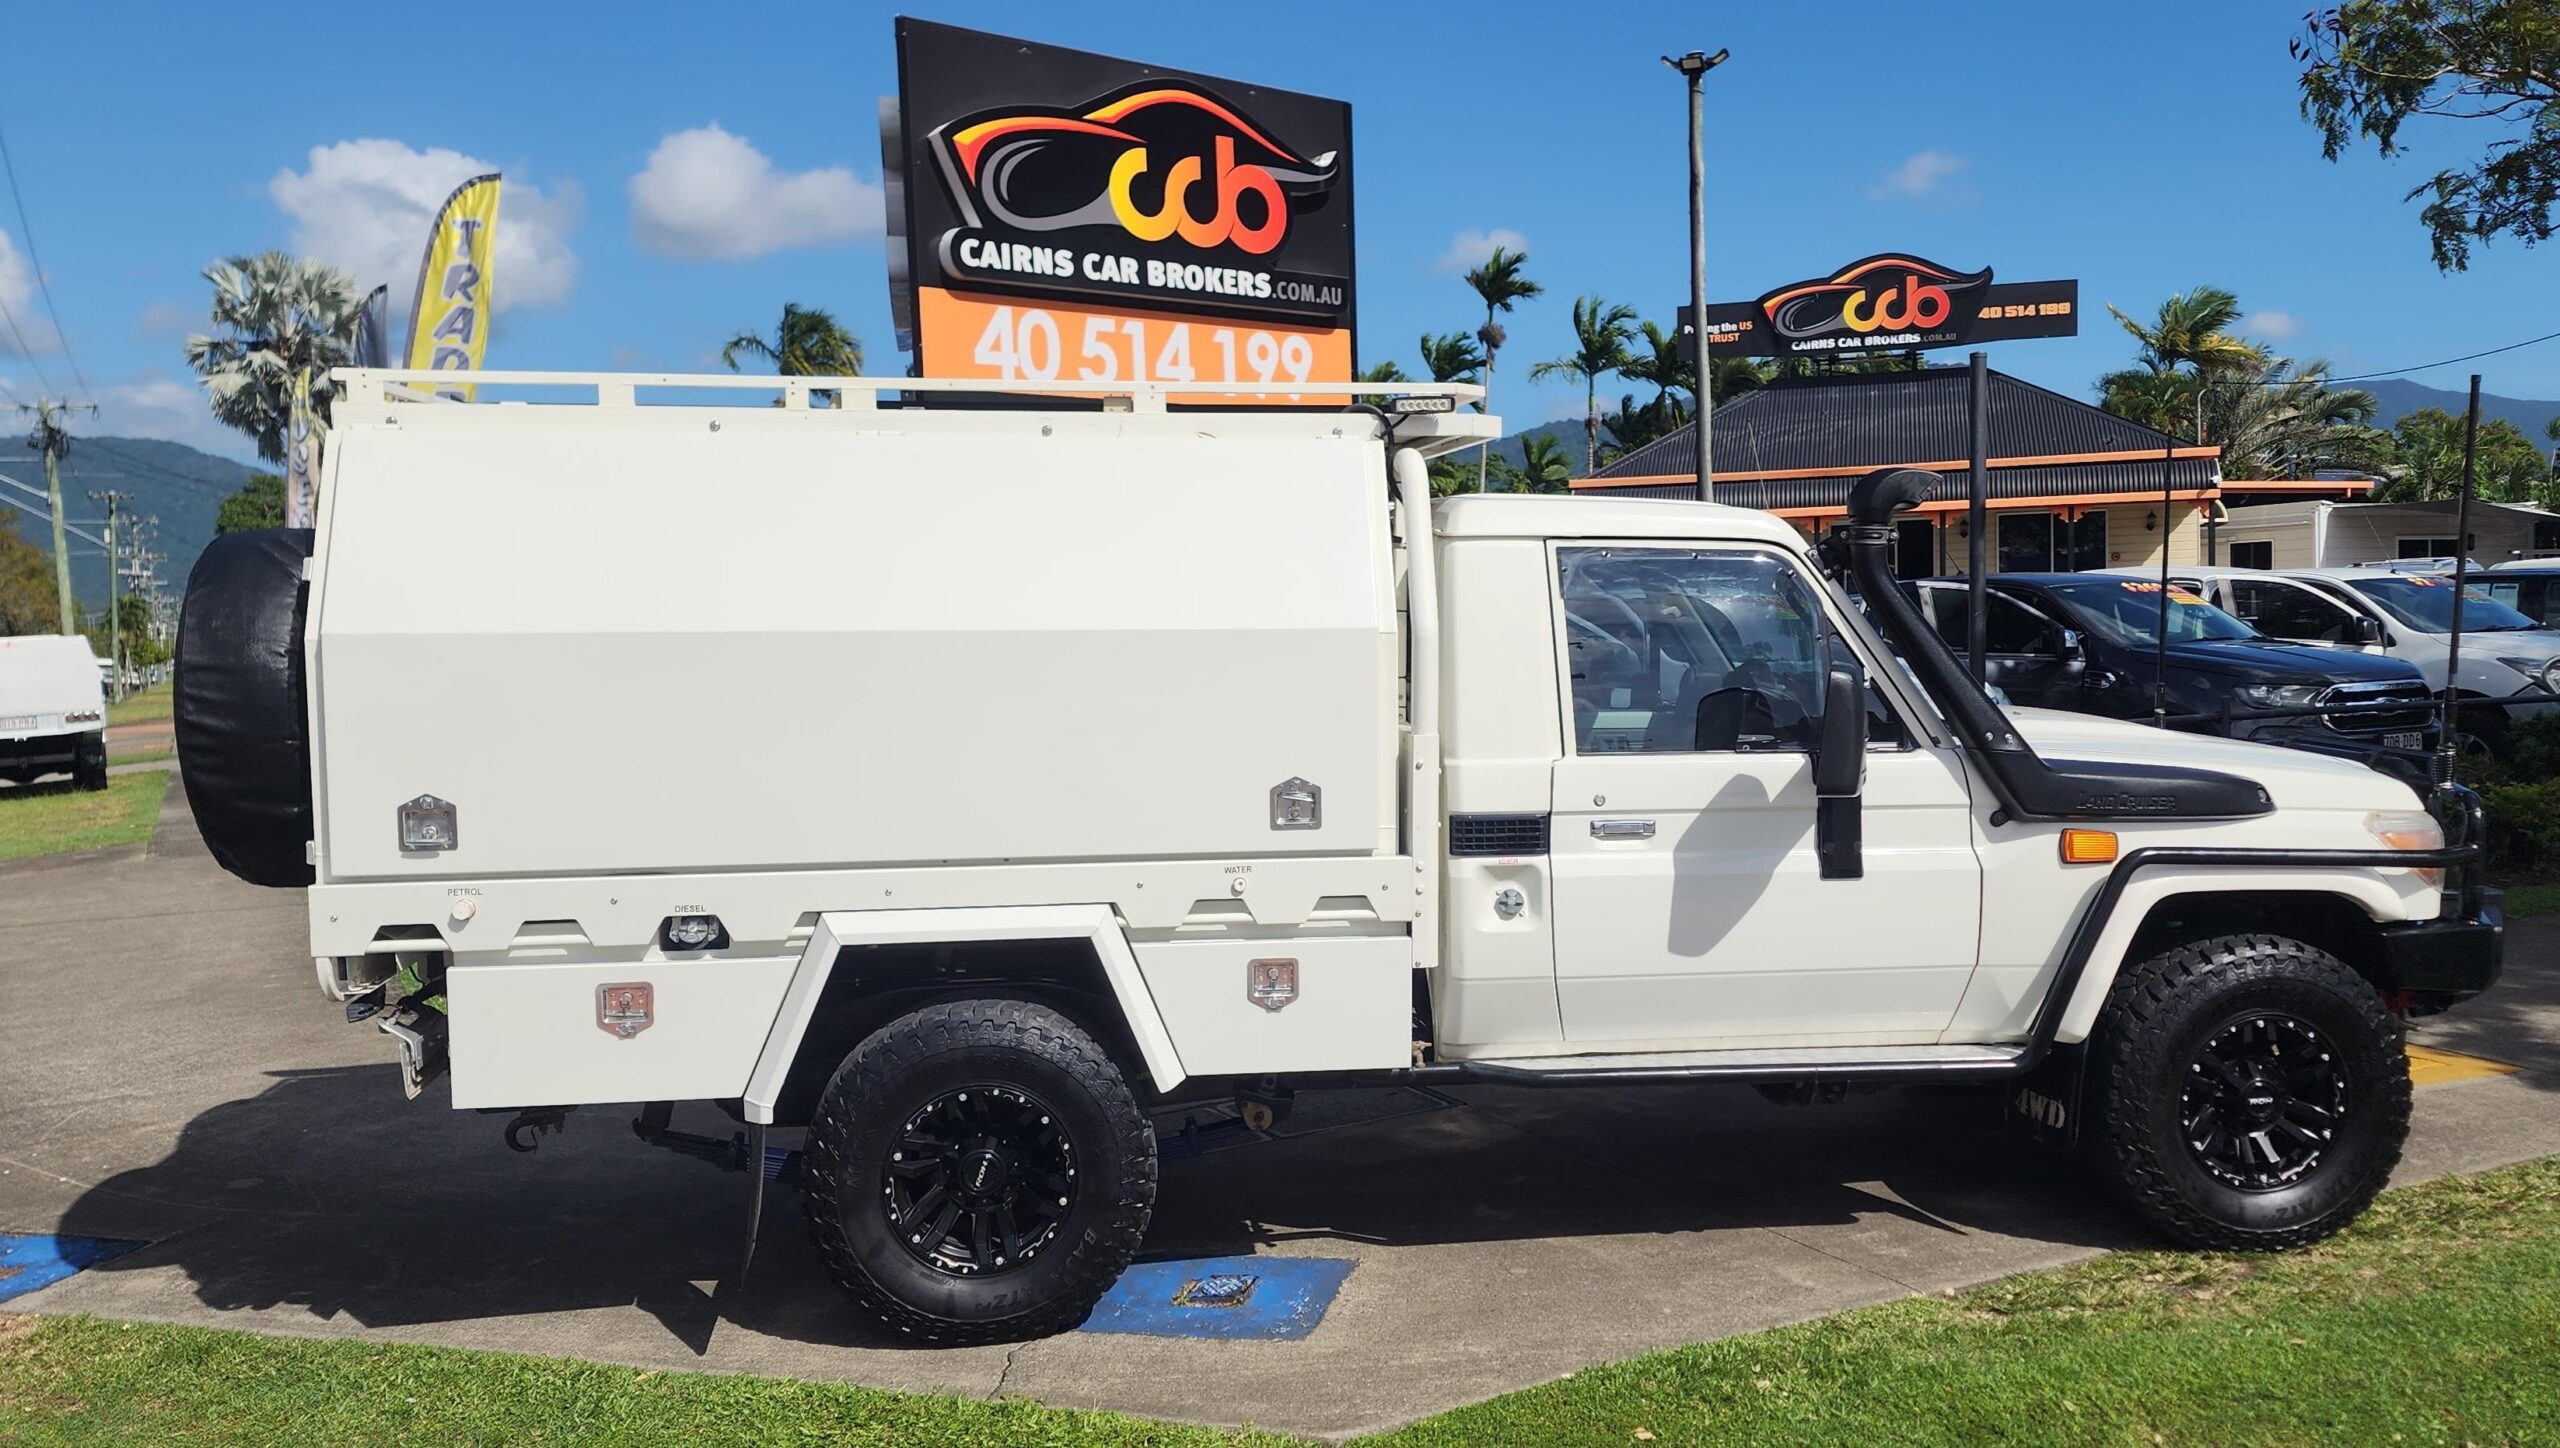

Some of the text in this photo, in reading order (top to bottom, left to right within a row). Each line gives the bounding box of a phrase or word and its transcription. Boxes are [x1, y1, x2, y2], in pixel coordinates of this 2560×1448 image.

[959, 237, 1075, 278] CAIRNS
[1082, 252, 1140, 285] CAR
[430, 217, 482, 401] TRAD
[1978, 306, 2002, 319] 40
[2004, 304, 2036, 318] 514
[1721, 322, 1738, 332] the
[1739, 320, 1754, 331] US
[1708, 332, 1741, 343] TRUST
[1791, 338, 1836, 351] CAIRNS
[1837, 336, 1862, 348] CAR
[973, 305, 1313, 402] 40 514 199
[2076, 791, 2177, 811] LAND CRUISER
[1223, 865, 1252, 875] WATER
[447, 888, 483, 897] PETROL
[674, 905, 707, 913] DIESEL
[2016, 1088, 2066, 1129] 4WD
